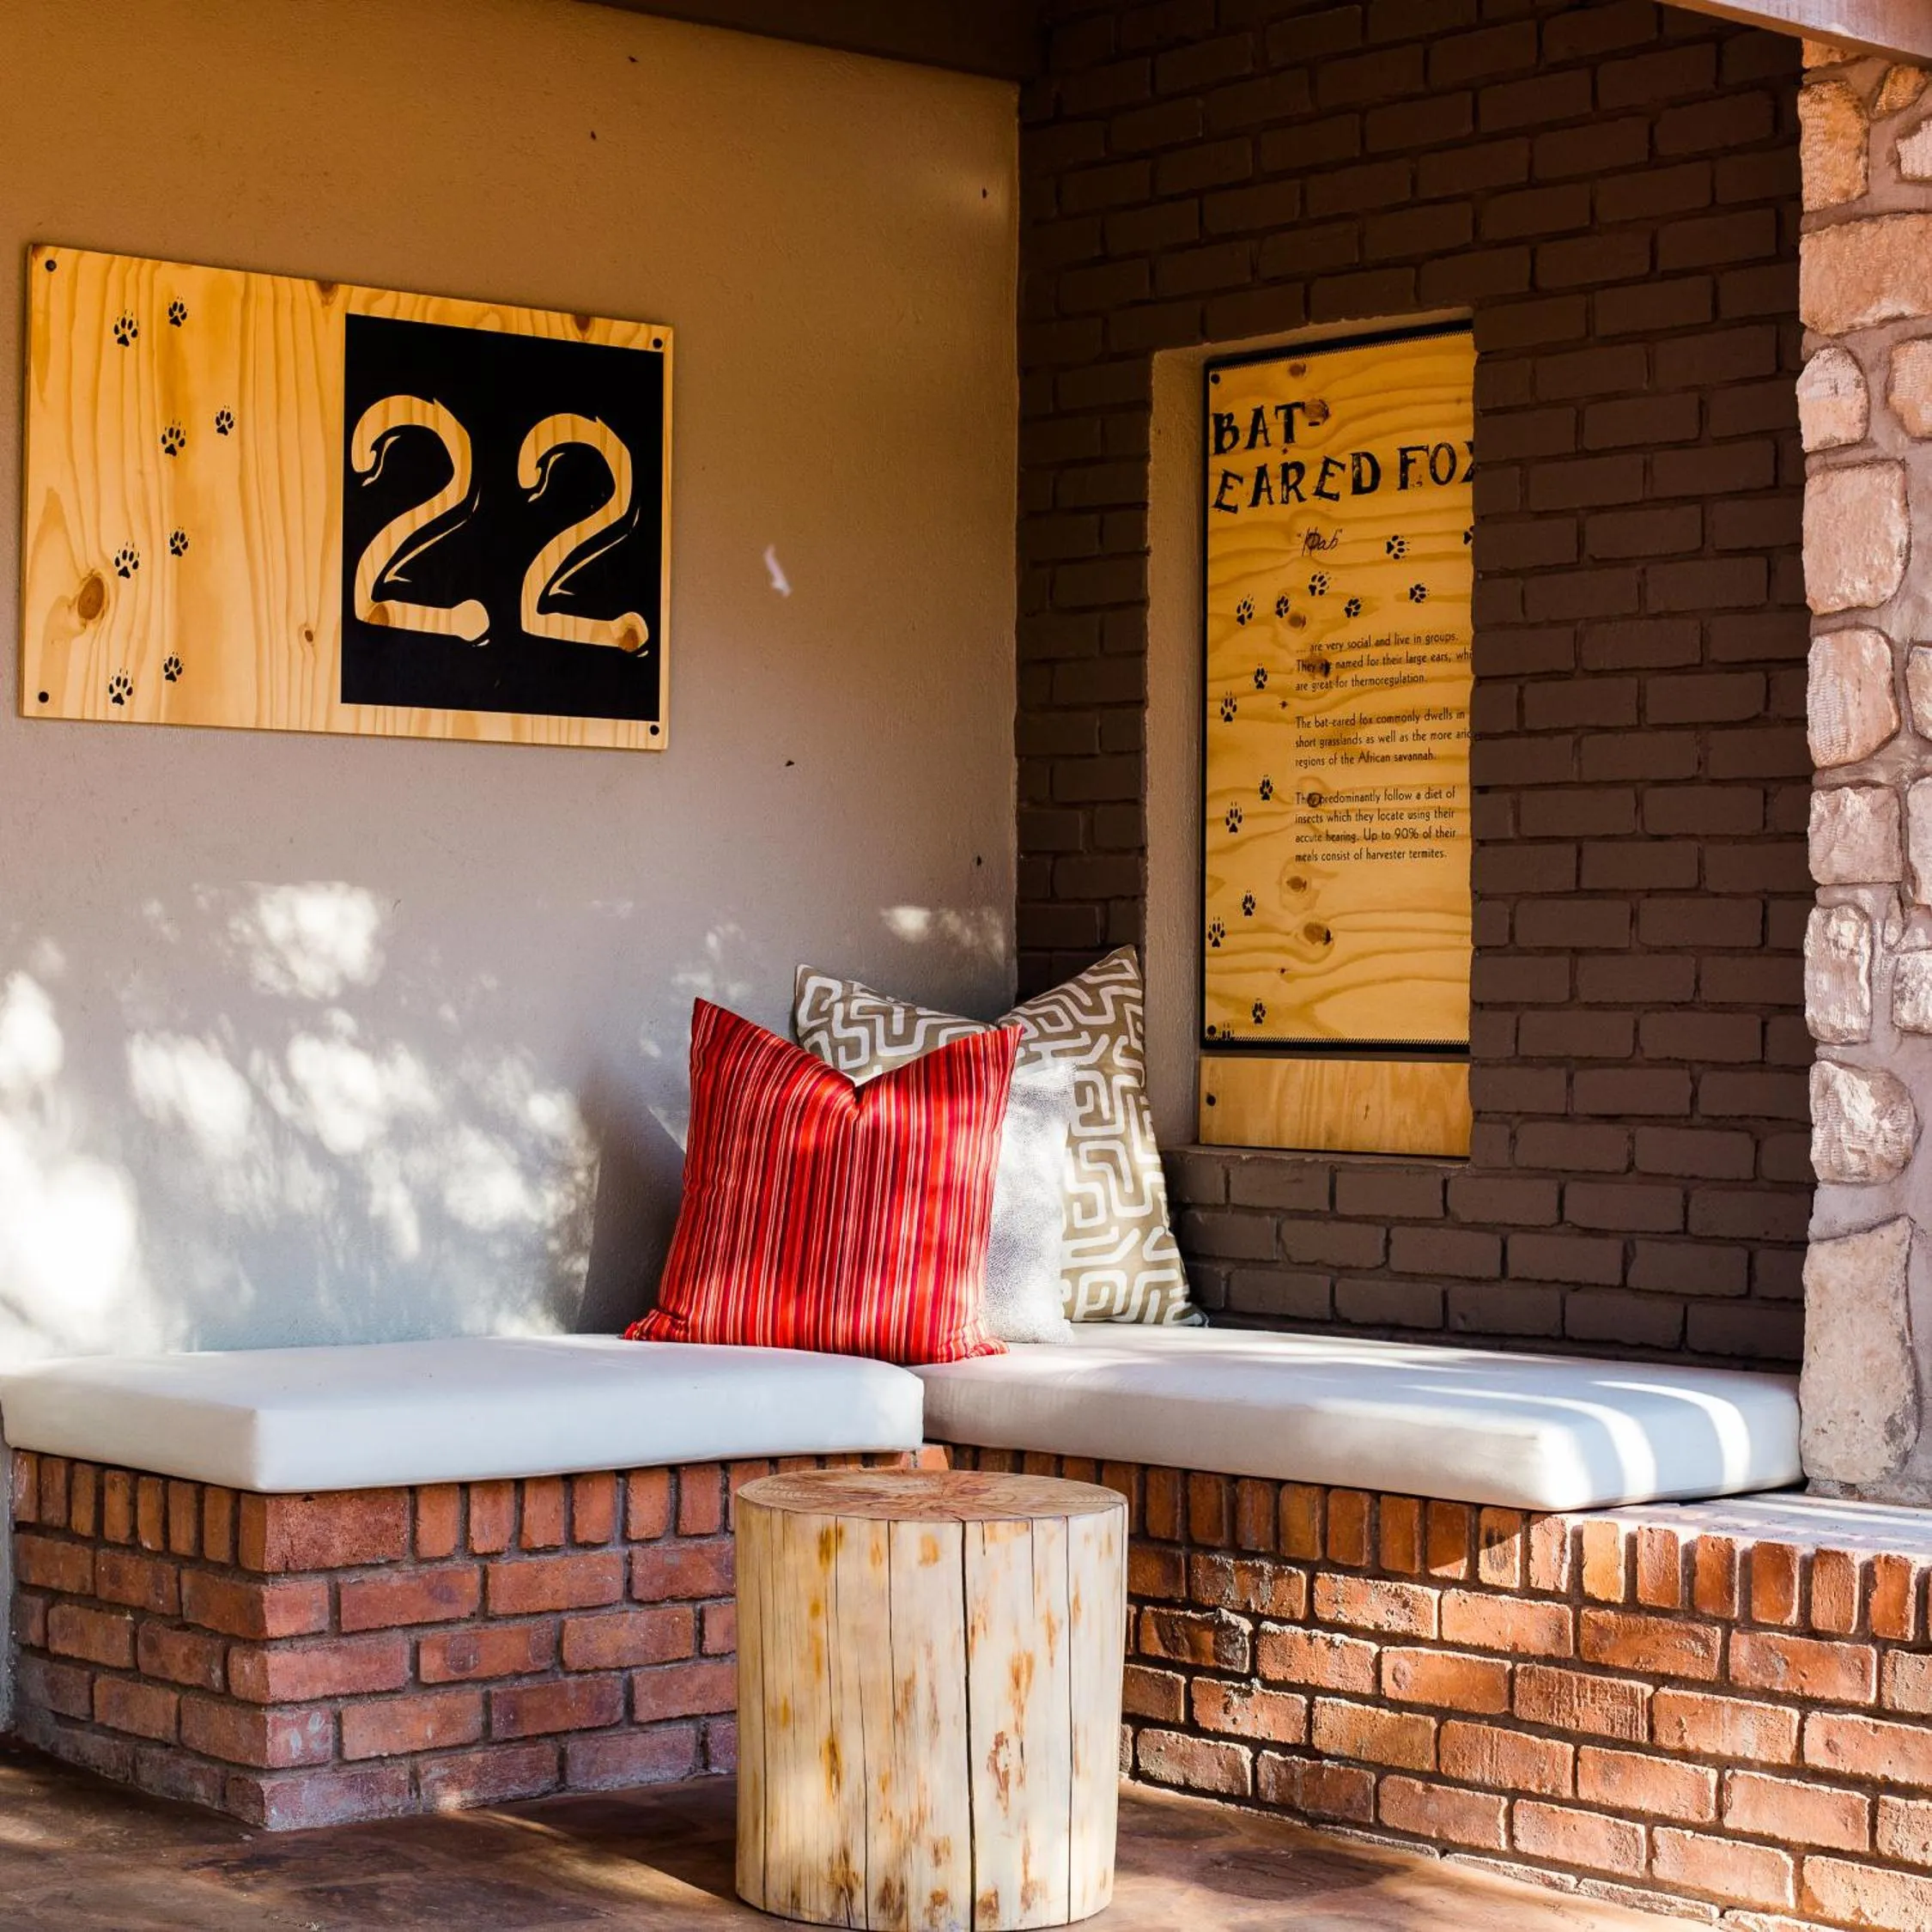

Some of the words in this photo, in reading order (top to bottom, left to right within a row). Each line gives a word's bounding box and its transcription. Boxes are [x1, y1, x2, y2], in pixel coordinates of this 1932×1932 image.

[1212, 401, 1321, 455] BAT-
[1212, 452, 1382, 514] EARED
[351, 393, 650, 658] 22
[1309, 644, 1322, 653] are
[1326, 641, 1344, 653] very
[1347, 635, 1371, 649] social
[1374, 632, 1391, 647] and
[1394, 632, 1410, 646] live
[1413, 633, 1422, 644] in
[1425, 632, 1459, 647] groups.
[1296, 659, 1316, 673] They
[1366, 653, 1380, 667] for
[1382, 651, 1401, 665] their
[1406, 649, 1427, 665] large
[1430, 653, 1452, 664] ears,
[1295, 681, 1308, 691] are
[1311, 679, 1334, 693] great
[1335, 675, 1348, 689] for
[1295, 716, 1311, 729] The
[1315, 713, 1356, 728] bat-eared
[1359, 712, 1373, 726] fox
[1376, 708, 1420, 725] commonly
[1425, 706, 1453, 721] dwells
[1456, 710, 1465, 720] in
[1295, 735, 1316, 749] short
[1319, 732, 1362, 750] grasslands
[1365, 735, 1375, 744] as
[1378, 730, 1396, 744] well
[1400, 733, 1409, 743] as
[1413, 727, 1426, 742] the
[1430, 732, 1452, 742] more
[1295, 756, 1325, 769] regions
[1328, 750, 1338, 764] of
[1340, 751, 1355, 764] the
[1358, 750, 1391, 763] African
[1394, 747, 1437, 762] savannah.
[1320, 790, 1381, 805] predominantly
[1384, 788, 1413, 802] follow
[1425, 787, 1443, 799] diet
[1446, 786, 1455, 799] of
[1295, 813, 1323, 824] insects
[1327, 809, 1352, 823] which
[1355, 809, 1374, 823] they
[1377, 807, 1404, 821] locate
[1407, 809, 1431, 822] using
[1434, 806, 1455, 818] their
[1326, 829, 1359, 843] hearing.
[1363, 827, 1377, 842] Up
[1381, 829, 1391, 841] to
[1394, 827, 1419, 840] 90%
[1423, 825, 1432, 839] of
[1436, 824, 1455, 838] their
[1295, 848, 1318, 863] meals
[1321, 849, 1350, 861] consist
[1353, 847, 1363, 860] of
[1366, 846, 1405, 860] harvester
[1409, 848, 1447, 860] termites.
